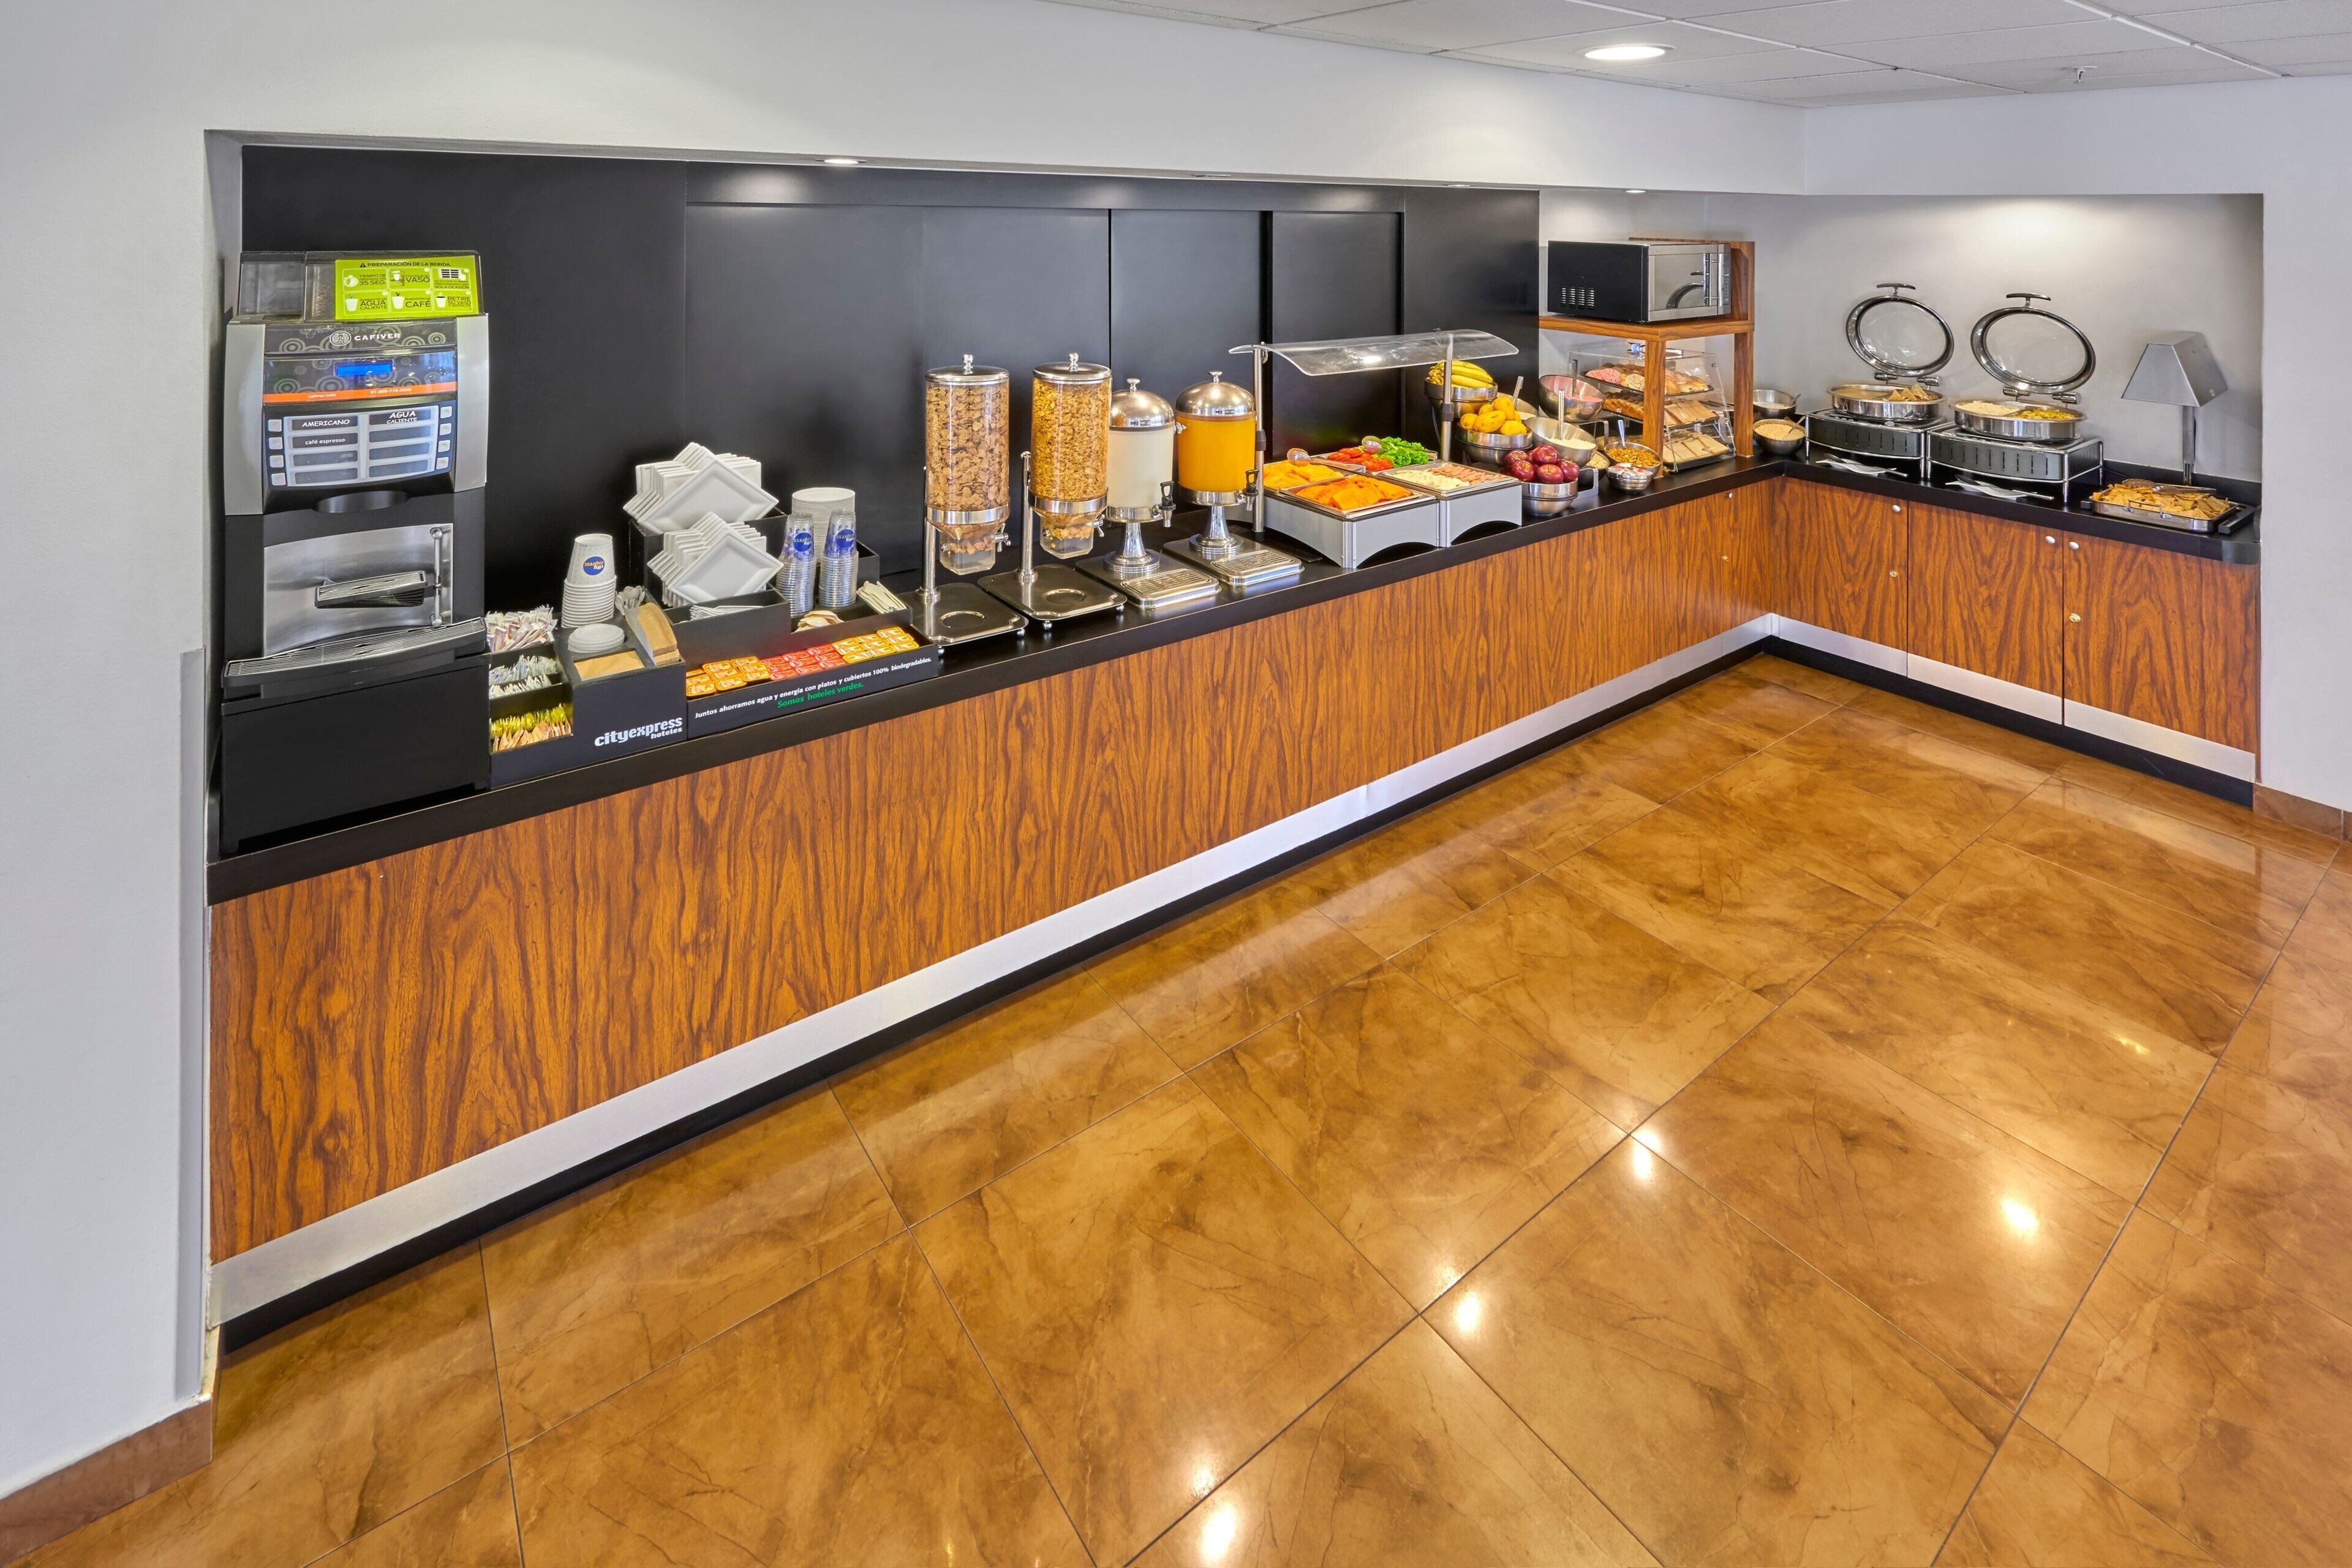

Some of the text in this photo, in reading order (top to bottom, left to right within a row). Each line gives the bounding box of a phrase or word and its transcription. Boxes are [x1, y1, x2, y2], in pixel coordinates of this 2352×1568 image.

[405, 299, 431, 307] CAFÉ
[354, 333, 401, 341] CAFIVER
[389, 410, 416, 419] AGUA
[695, 709, 718, 718] Juntos
[719, 699, 756, 713] ahorramos
[756, 695, 773, 704] agua
[780, 687, 804, 698] energía
[804, 684, 817, 693] con
[817, 679, 837, 691] platos
[843, 671, 872, 683] cubiertos
[873, 667, 890, 676] 100%
[891, 657, 932, 672] biodegradables.
[777, 682, 864, 708] Somos hoteles verdes.
[594, 717, 683, 747] cityexpress
[650, 727, 683, 739] hoteles
